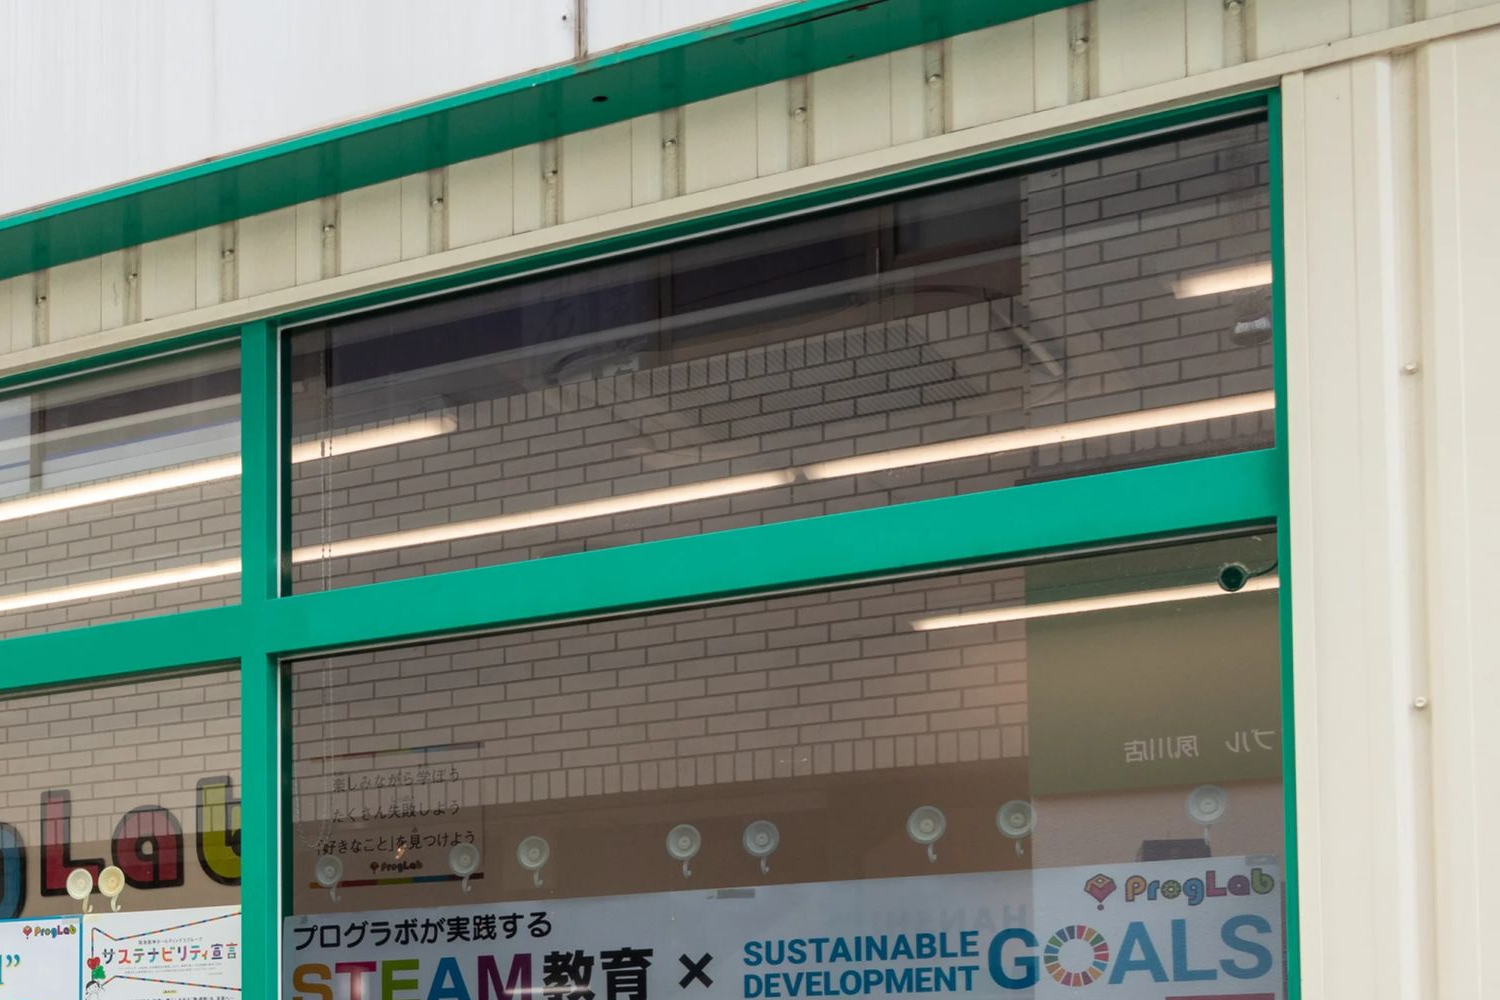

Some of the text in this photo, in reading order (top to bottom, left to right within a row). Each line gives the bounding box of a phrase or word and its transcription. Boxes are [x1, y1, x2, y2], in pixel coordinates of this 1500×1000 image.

[332, 767, 460, 792] 楽しみながら学ぼう
[332, 799, 461, 823] たくさん失敗しよう
[317, 830, 476, 856] 「好きなこと」を見つけよう
[381, 858, 424, 873] ProgLab
[1124, 867, 1275, 906] ProgLab
[34, 924, 77, 938] ProgLab
[293, 911, 553, 951] プログラボが実践する
[102, 942, 238, 965] サステナビリティ宣言
[743, 930, 980, 967] SUSTAINABLE
[987, 913, 1273, 990] GOALS
[743, 965, 980, 999] DEVELOPMENT
